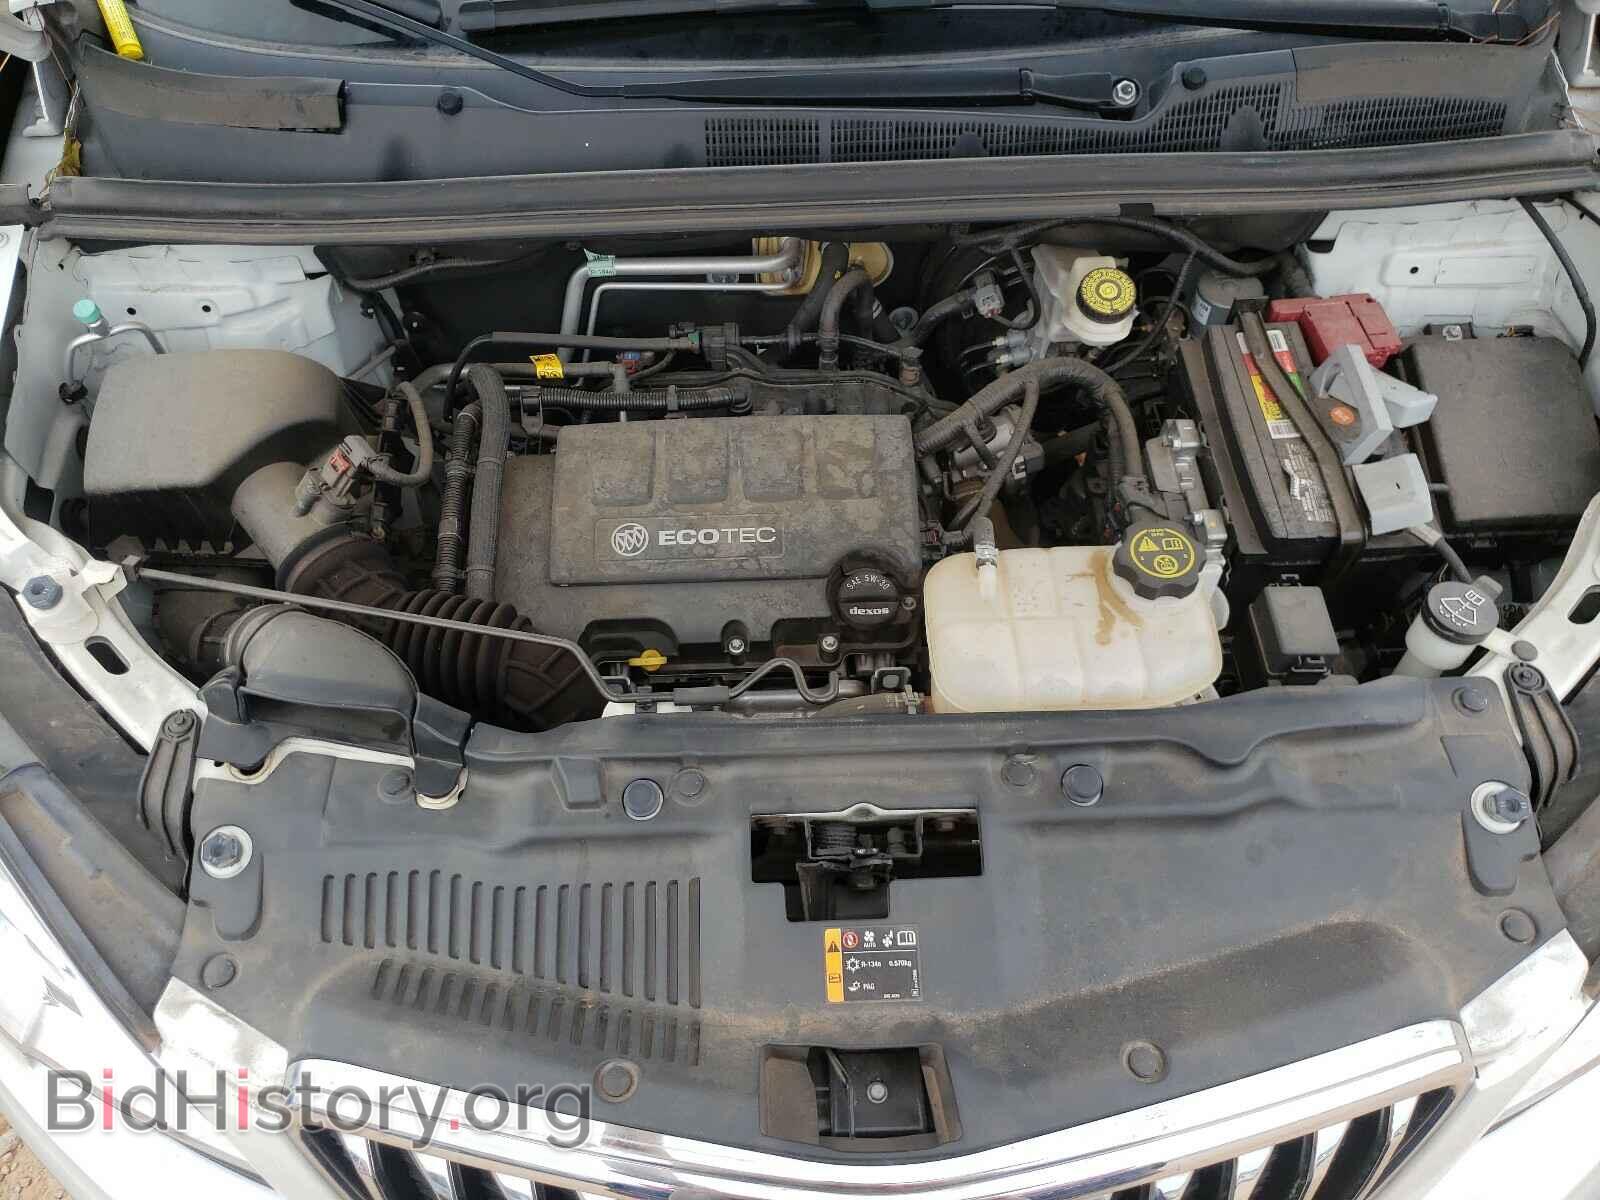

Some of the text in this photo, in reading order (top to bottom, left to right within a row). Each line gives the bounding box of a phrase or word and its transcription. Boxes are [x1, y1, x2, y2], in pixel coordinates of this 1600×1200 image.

[657, 526, 777, 546] ECOTEC
[846, 574, 890, 590] SAE 5W-30
[849, 606, 890, 615] dexos
